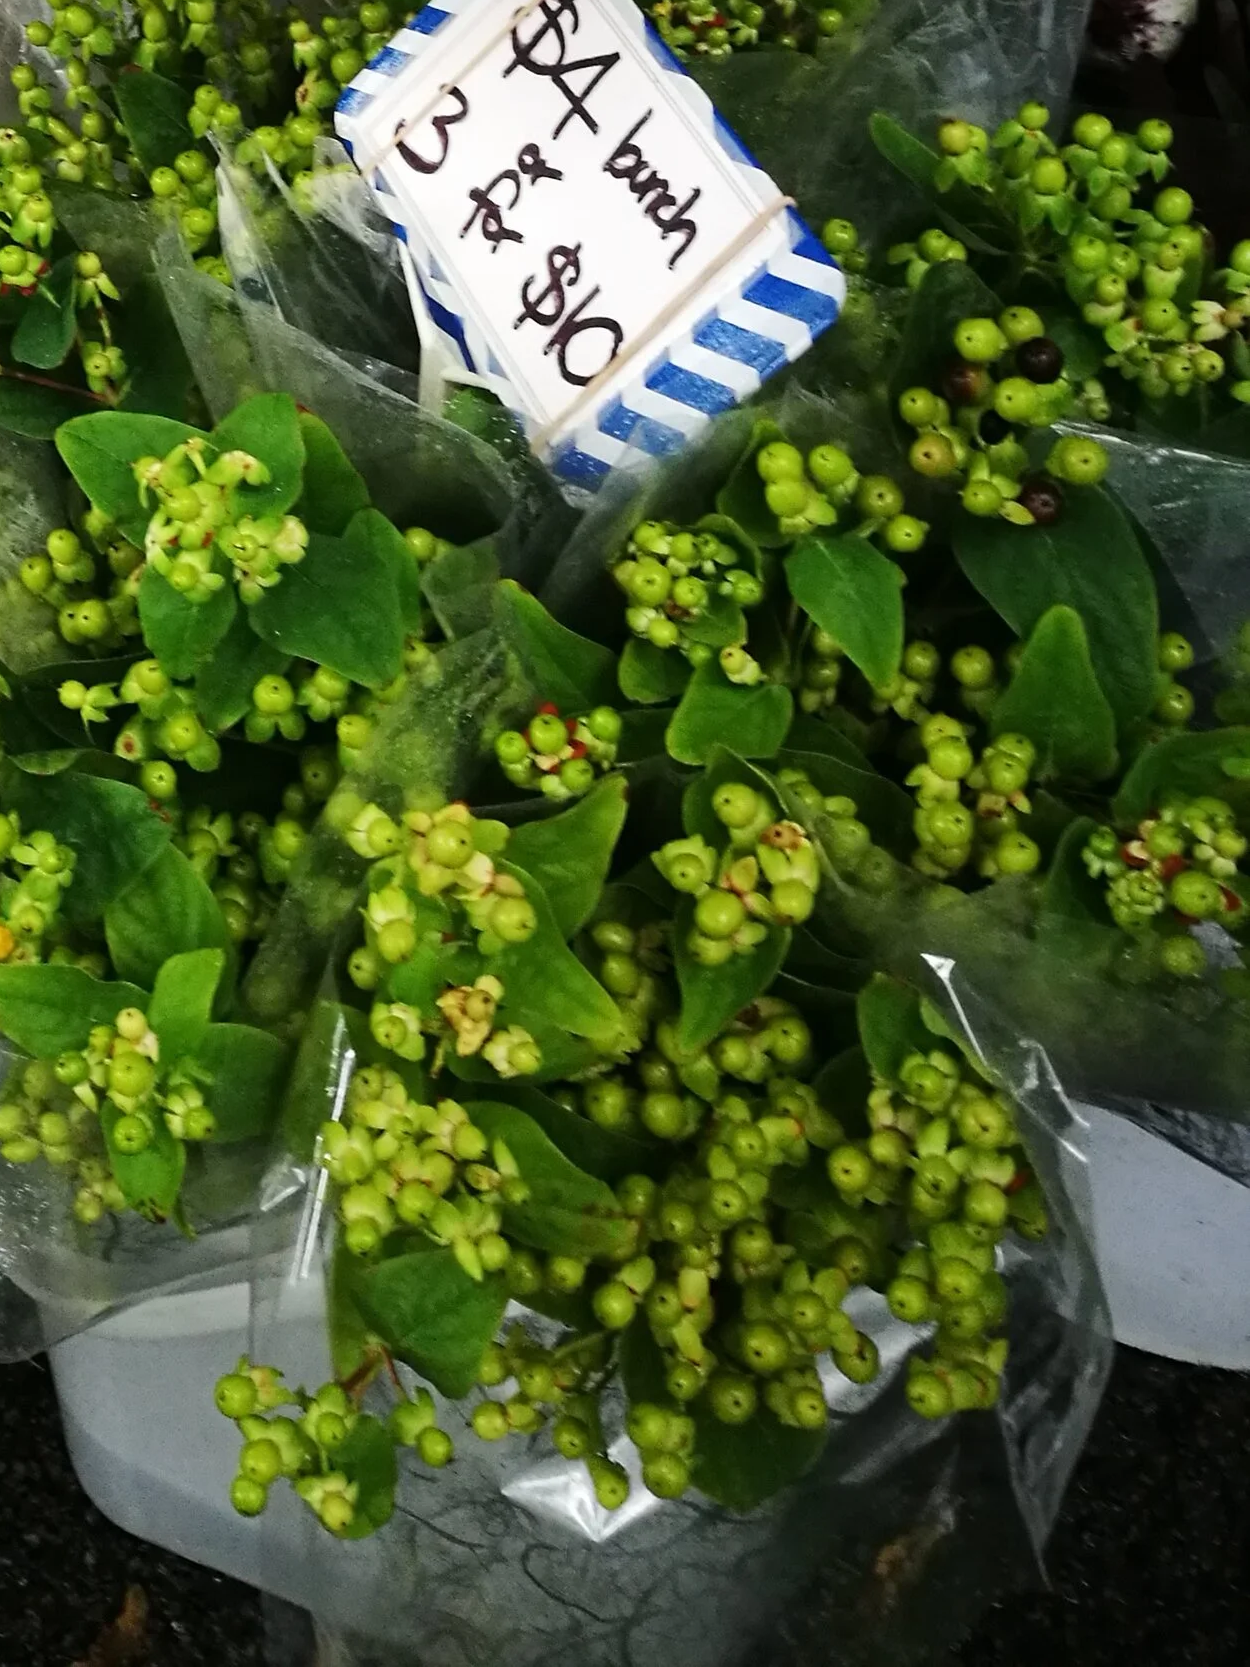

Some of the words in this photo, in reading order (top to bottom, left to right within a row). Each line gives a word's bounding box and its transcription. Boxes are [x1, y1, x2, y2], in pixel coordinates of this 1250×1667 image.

[395, 83, 469, 175] 3
[513, 242, 624, 387] $10
[517, 142, 563, 182] or
[603, 108, 701, 270] bunch
